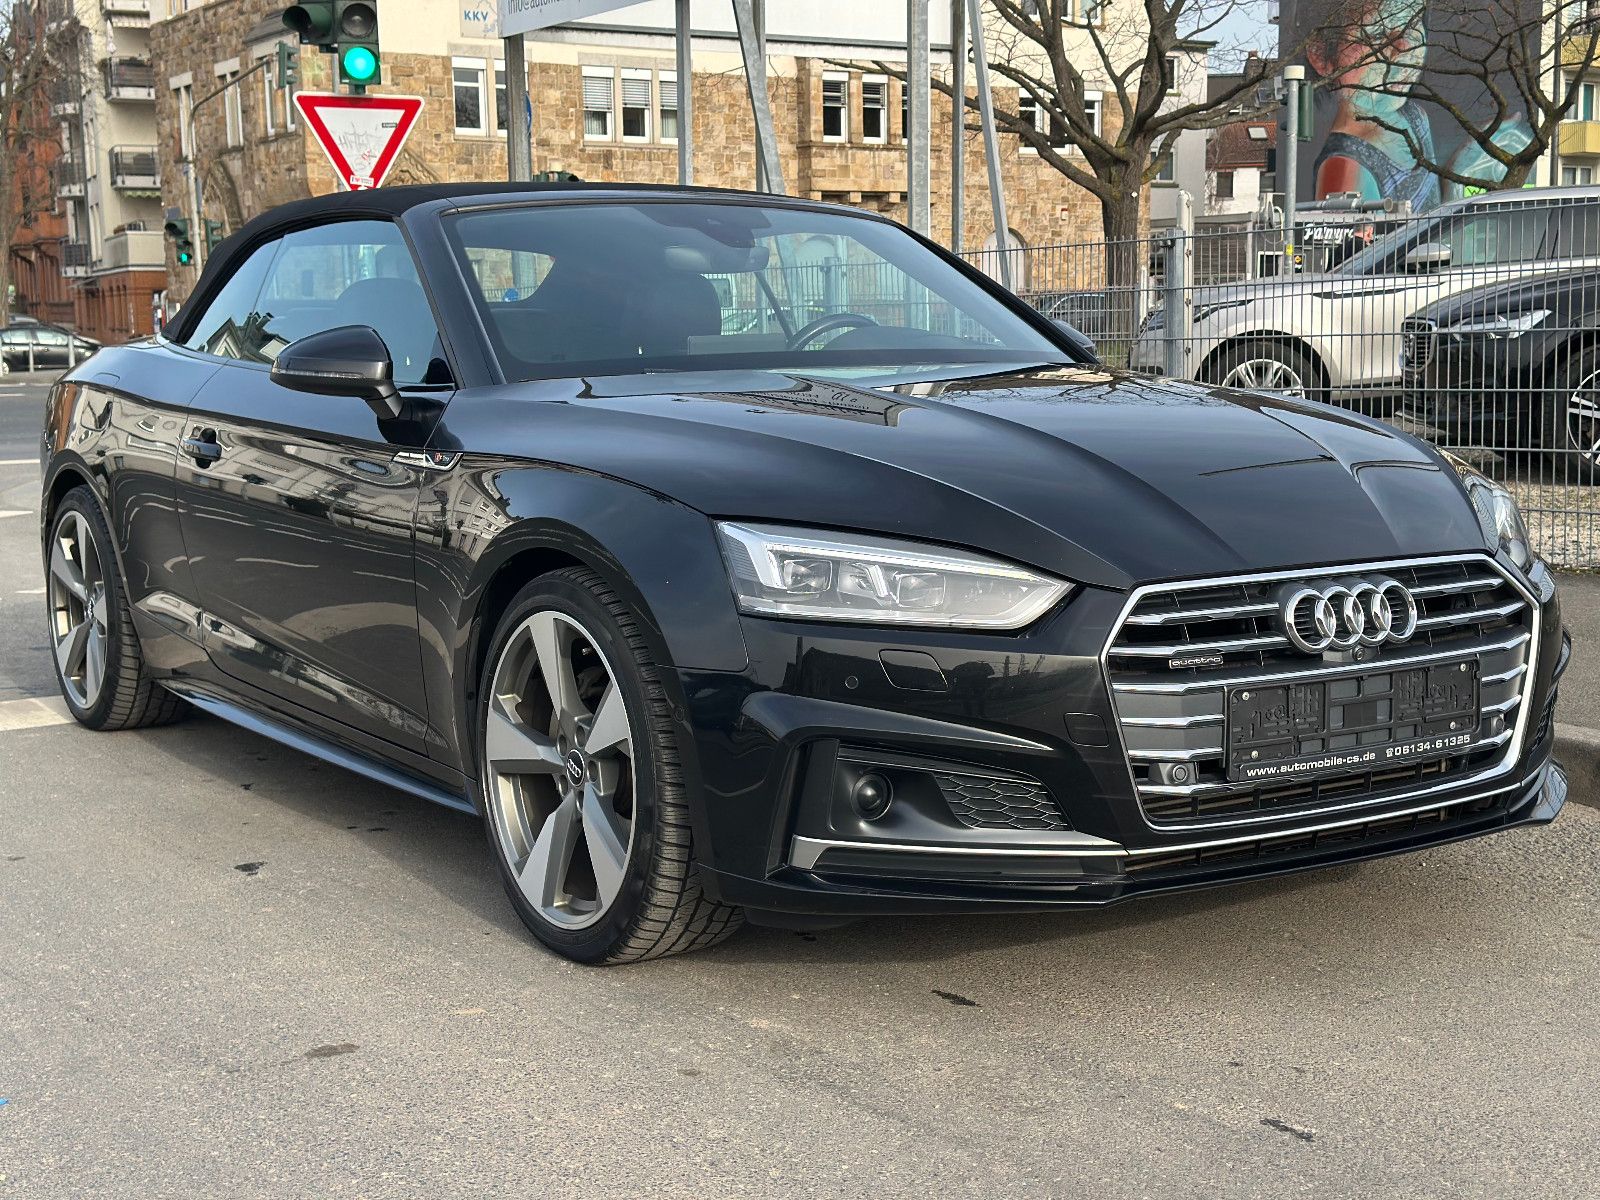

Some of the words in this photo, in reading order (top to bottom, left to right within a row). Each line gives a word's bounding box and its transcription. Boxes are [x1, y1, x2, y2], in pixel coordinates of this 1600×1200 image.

[464, 10, 488, 21] KKV
[1172, 656, 1221, 667] quattro
[1246, 752, 1376, 777] www.automobile-cs.de
